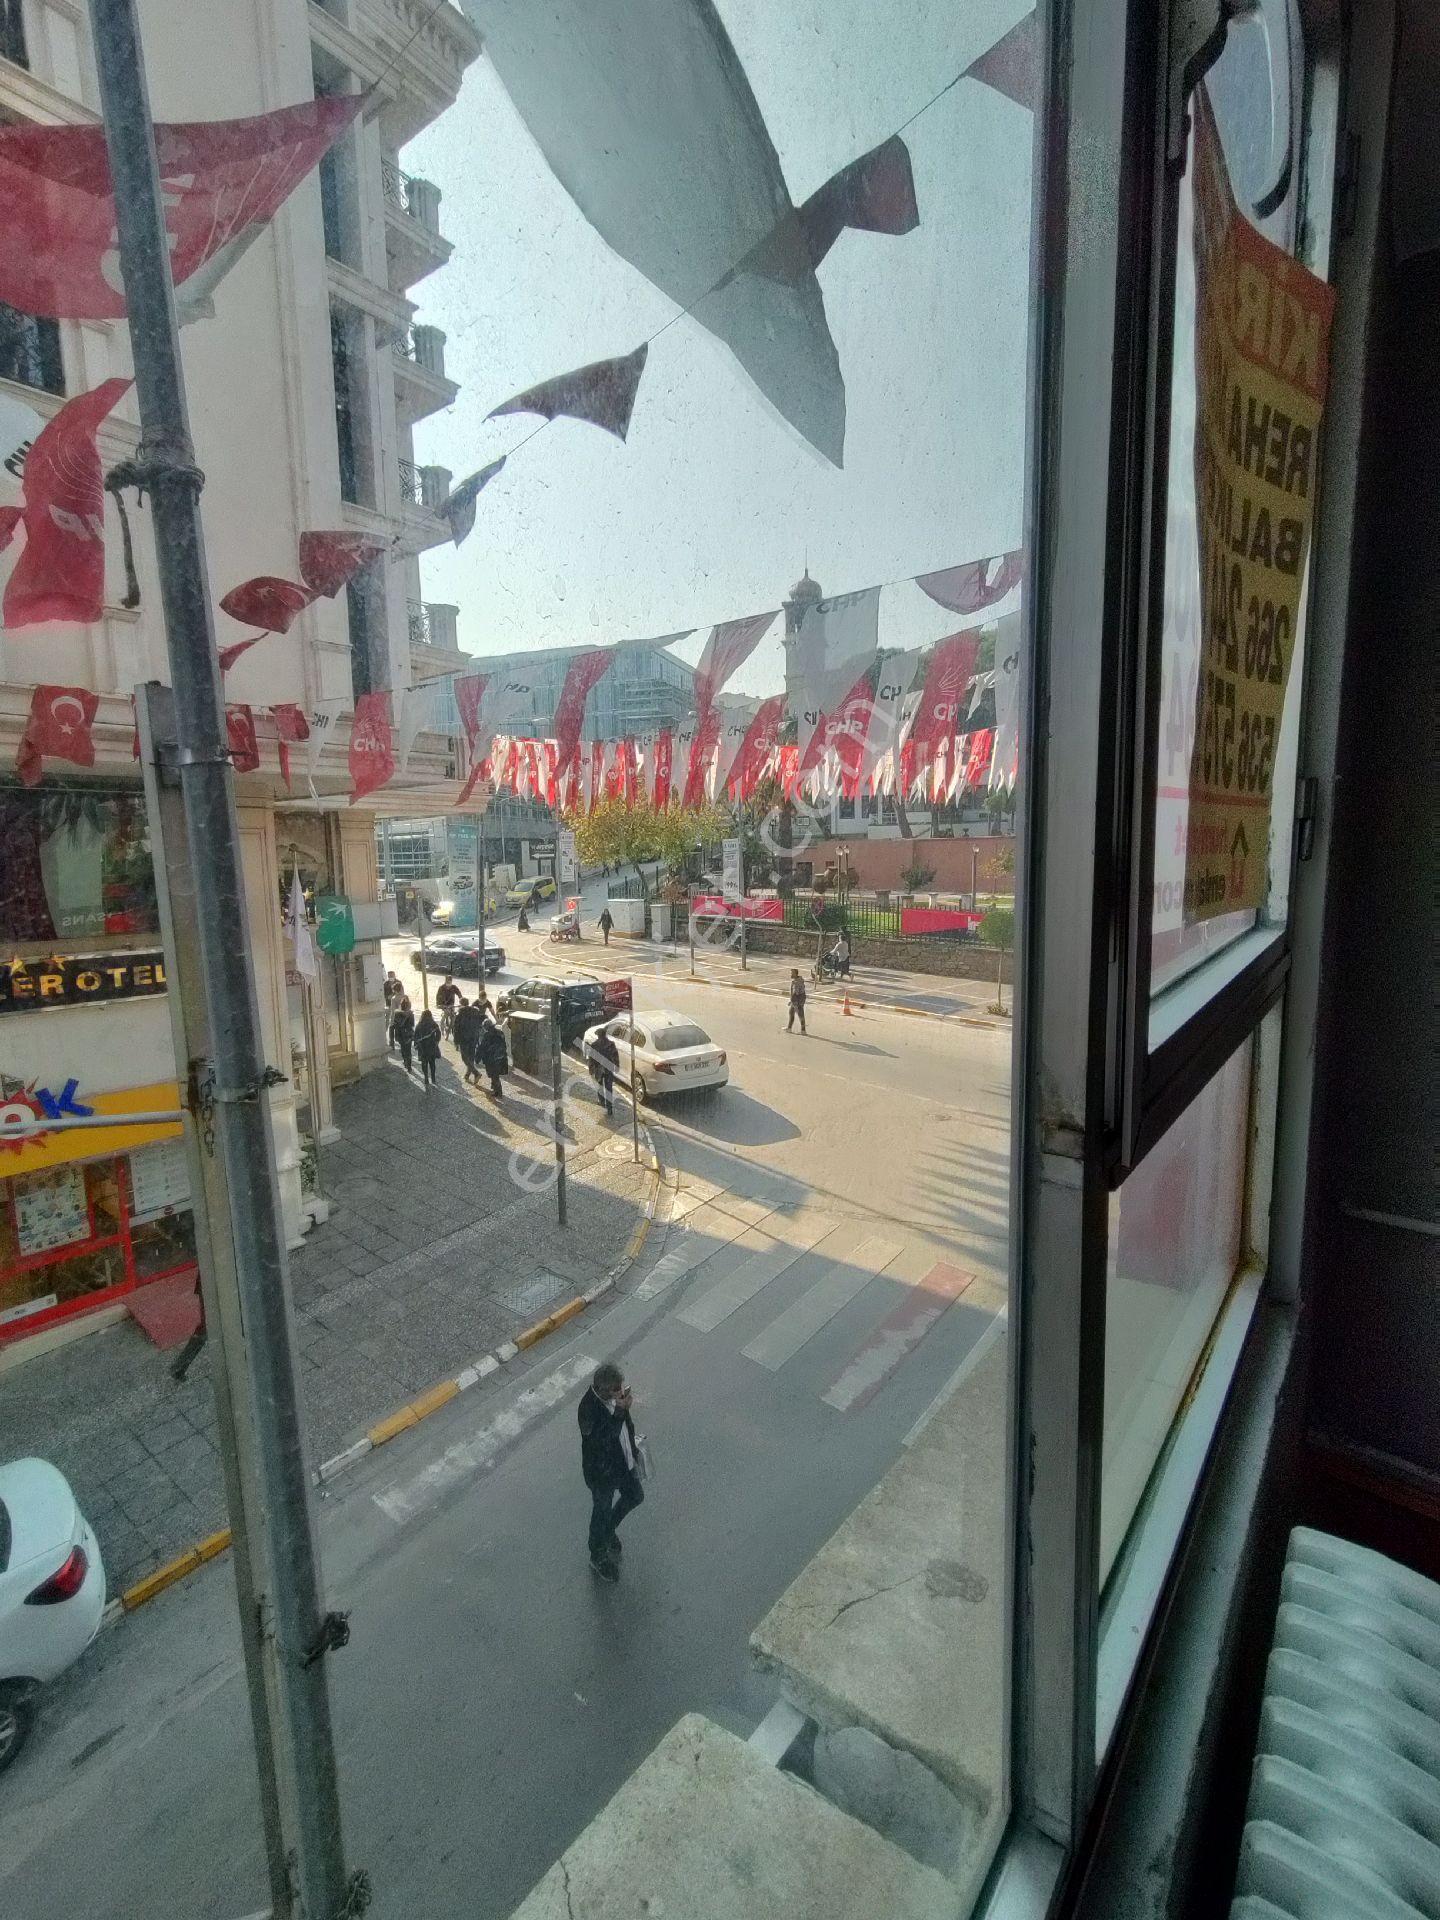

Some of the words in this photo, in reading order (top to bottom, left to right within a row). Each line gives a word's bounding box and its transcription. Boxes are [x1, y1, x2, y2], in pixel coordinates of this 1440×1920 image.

[825, 717, 863, 735] CHP
[0, 973, 65, 1000] ER
[75, 964, 167, 992] OTEL
